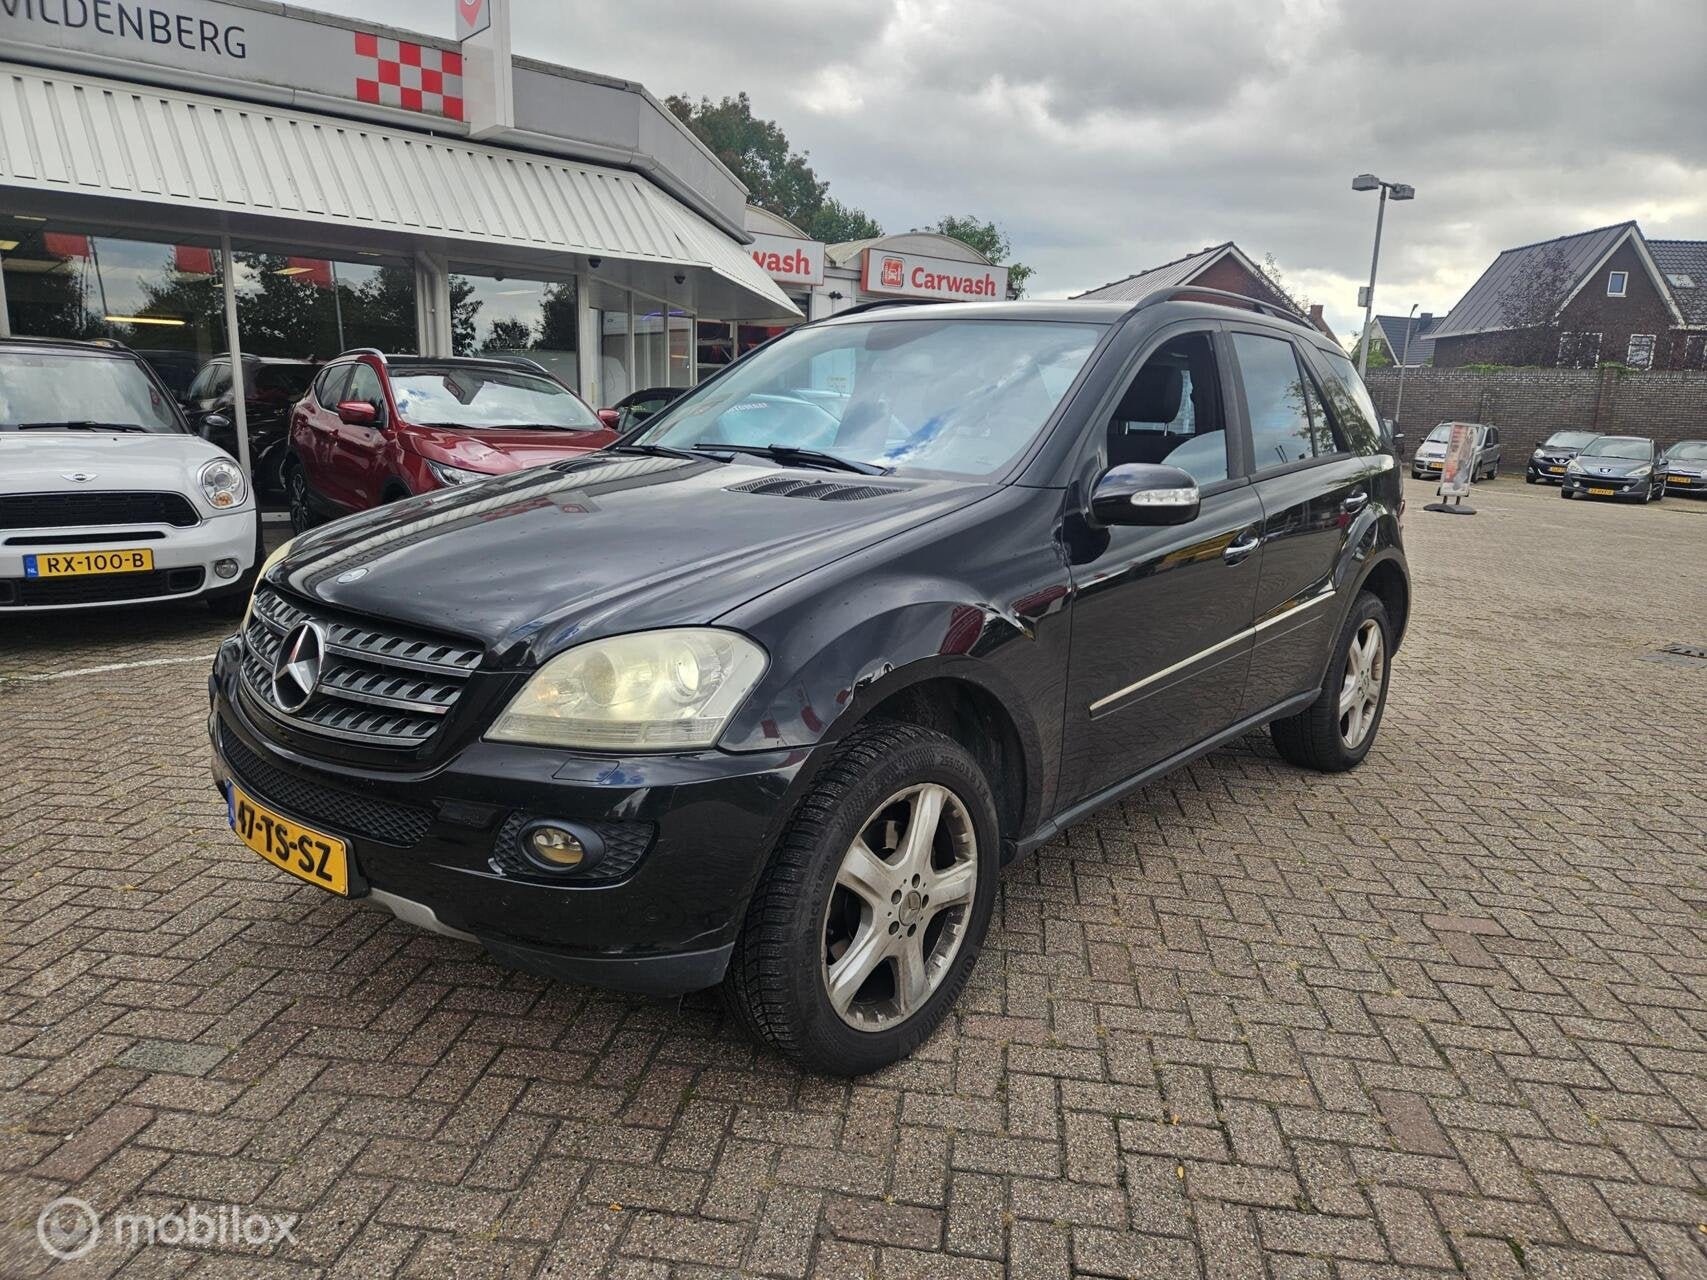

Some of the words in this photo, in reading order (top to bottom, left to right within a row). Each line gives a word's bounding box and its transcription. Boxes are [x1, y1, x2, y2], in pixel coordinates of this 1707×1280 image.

[0, 0, 247, 59] ILDENBERG
[911, 266, 997, 297] Carwash
[47, 552, 145, 574] RX-100-B
